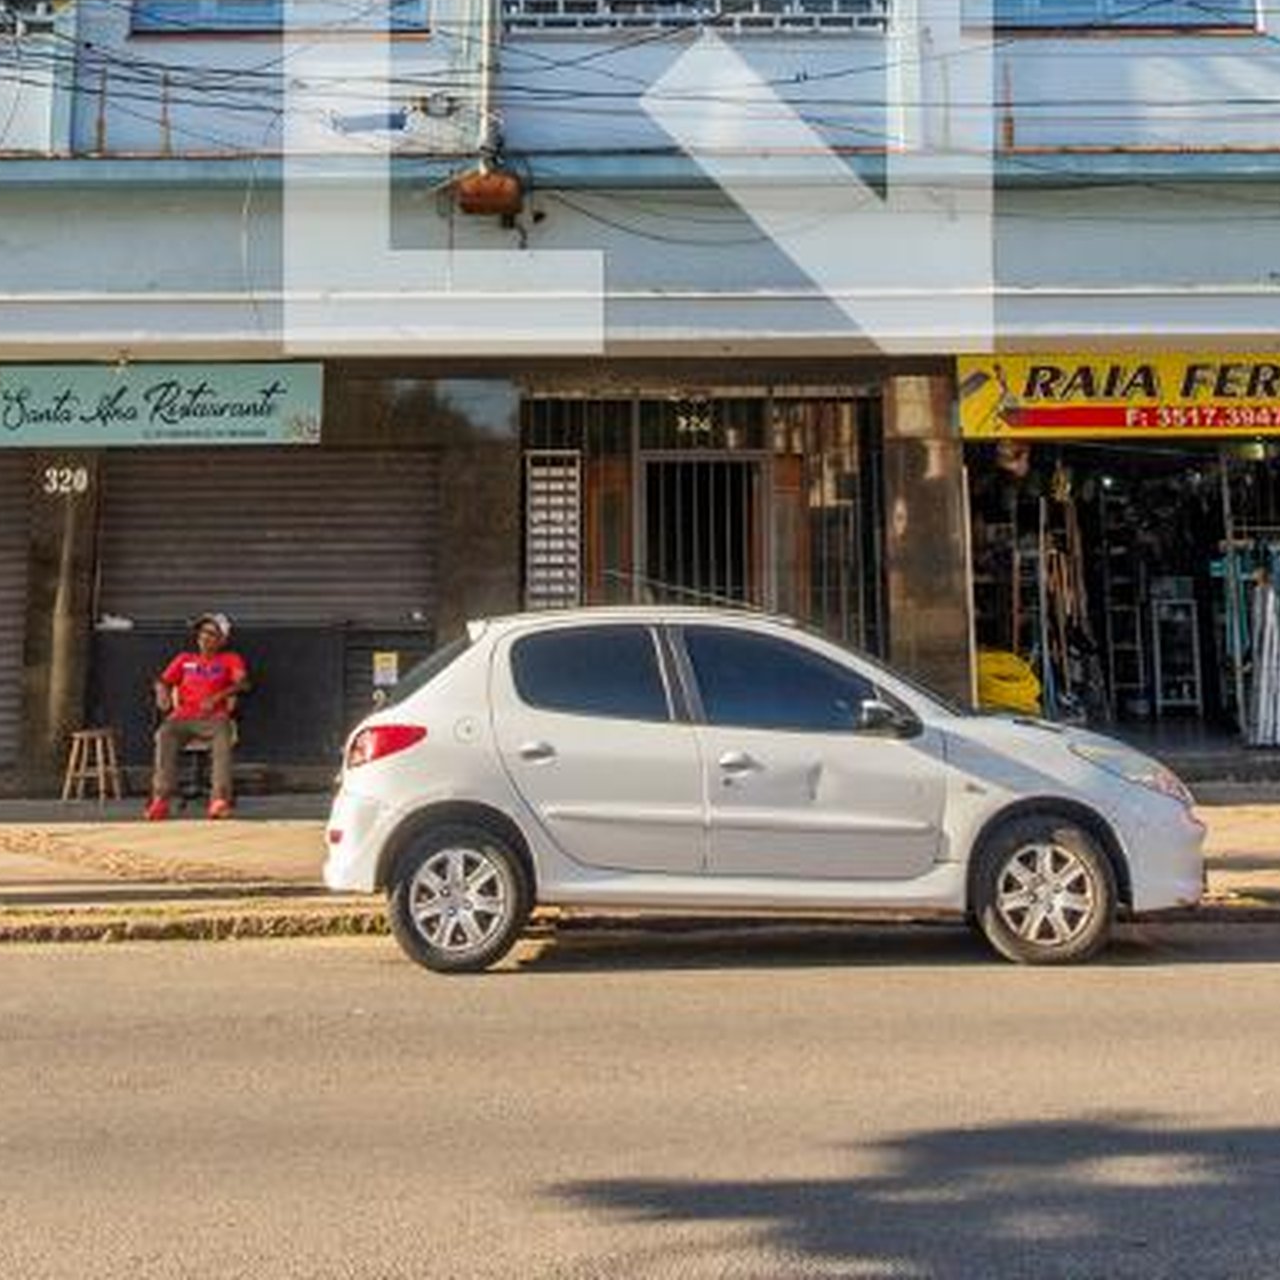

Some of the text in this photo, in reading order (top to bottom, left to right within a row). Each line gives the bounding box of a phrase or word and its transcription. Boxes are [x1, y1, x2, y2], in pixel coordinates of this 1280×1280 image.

[1023, 365, 1159, 399] RAIA
[4, 387, 77, 429] Santa
[80, 387, 138, 426] Ana
[43, 467, 88, 493] 320
